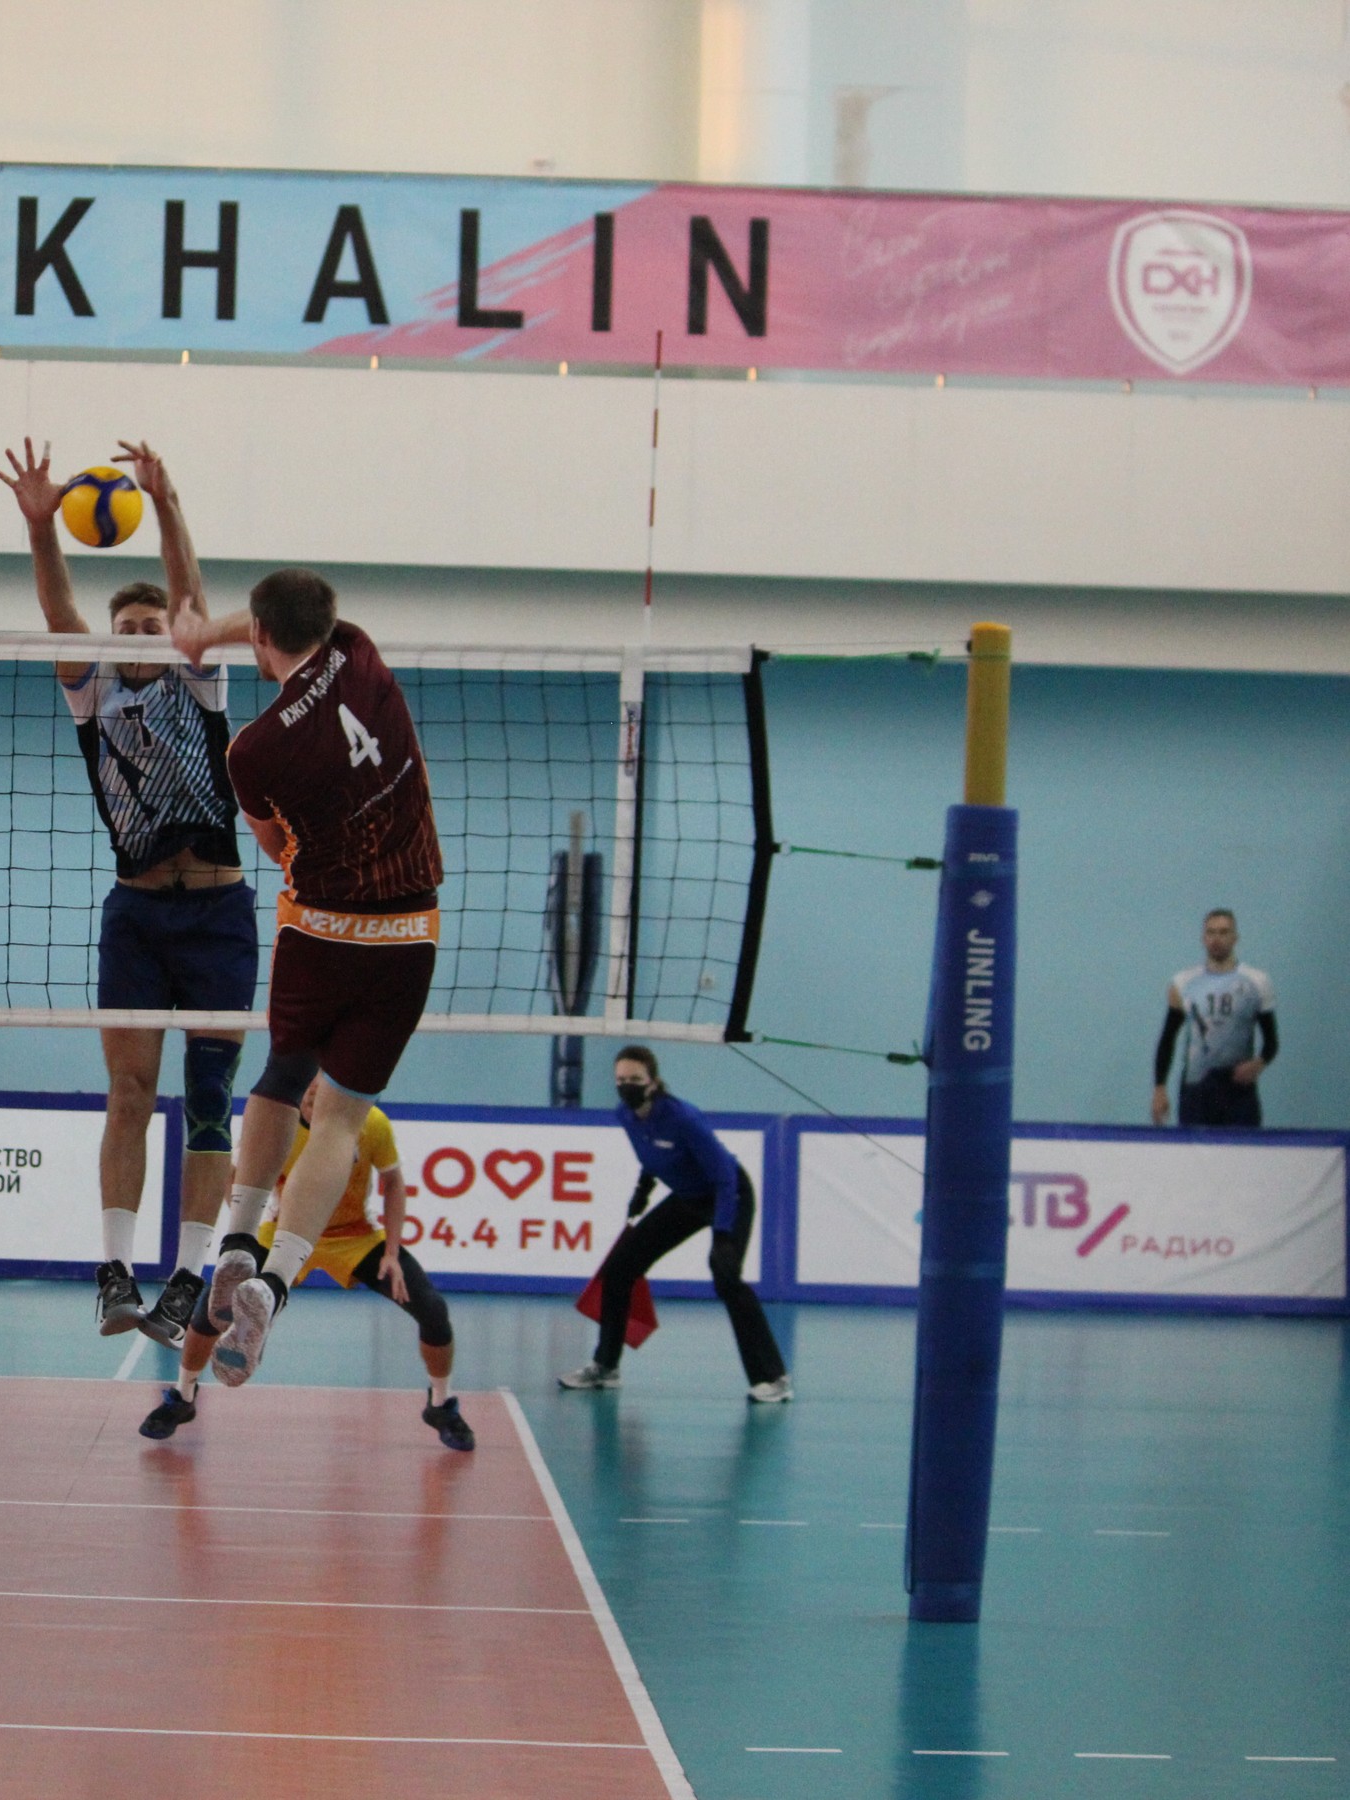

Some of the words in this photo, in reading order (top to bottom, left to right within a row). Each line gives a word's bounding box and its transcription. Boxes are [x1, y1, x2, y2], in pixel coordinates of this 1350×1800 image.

[121, 703, 153, 749] 7
[338, 703, 382, 768] 4
[301, 909, 352, 935] NEW
[354, 915, 429, 938] LEAGUE
[963, 928, 995, 1051] JINLING
[519, 1218, 593, 1251] FM
[1120, 1234, 1236, 1259] РАДИО
